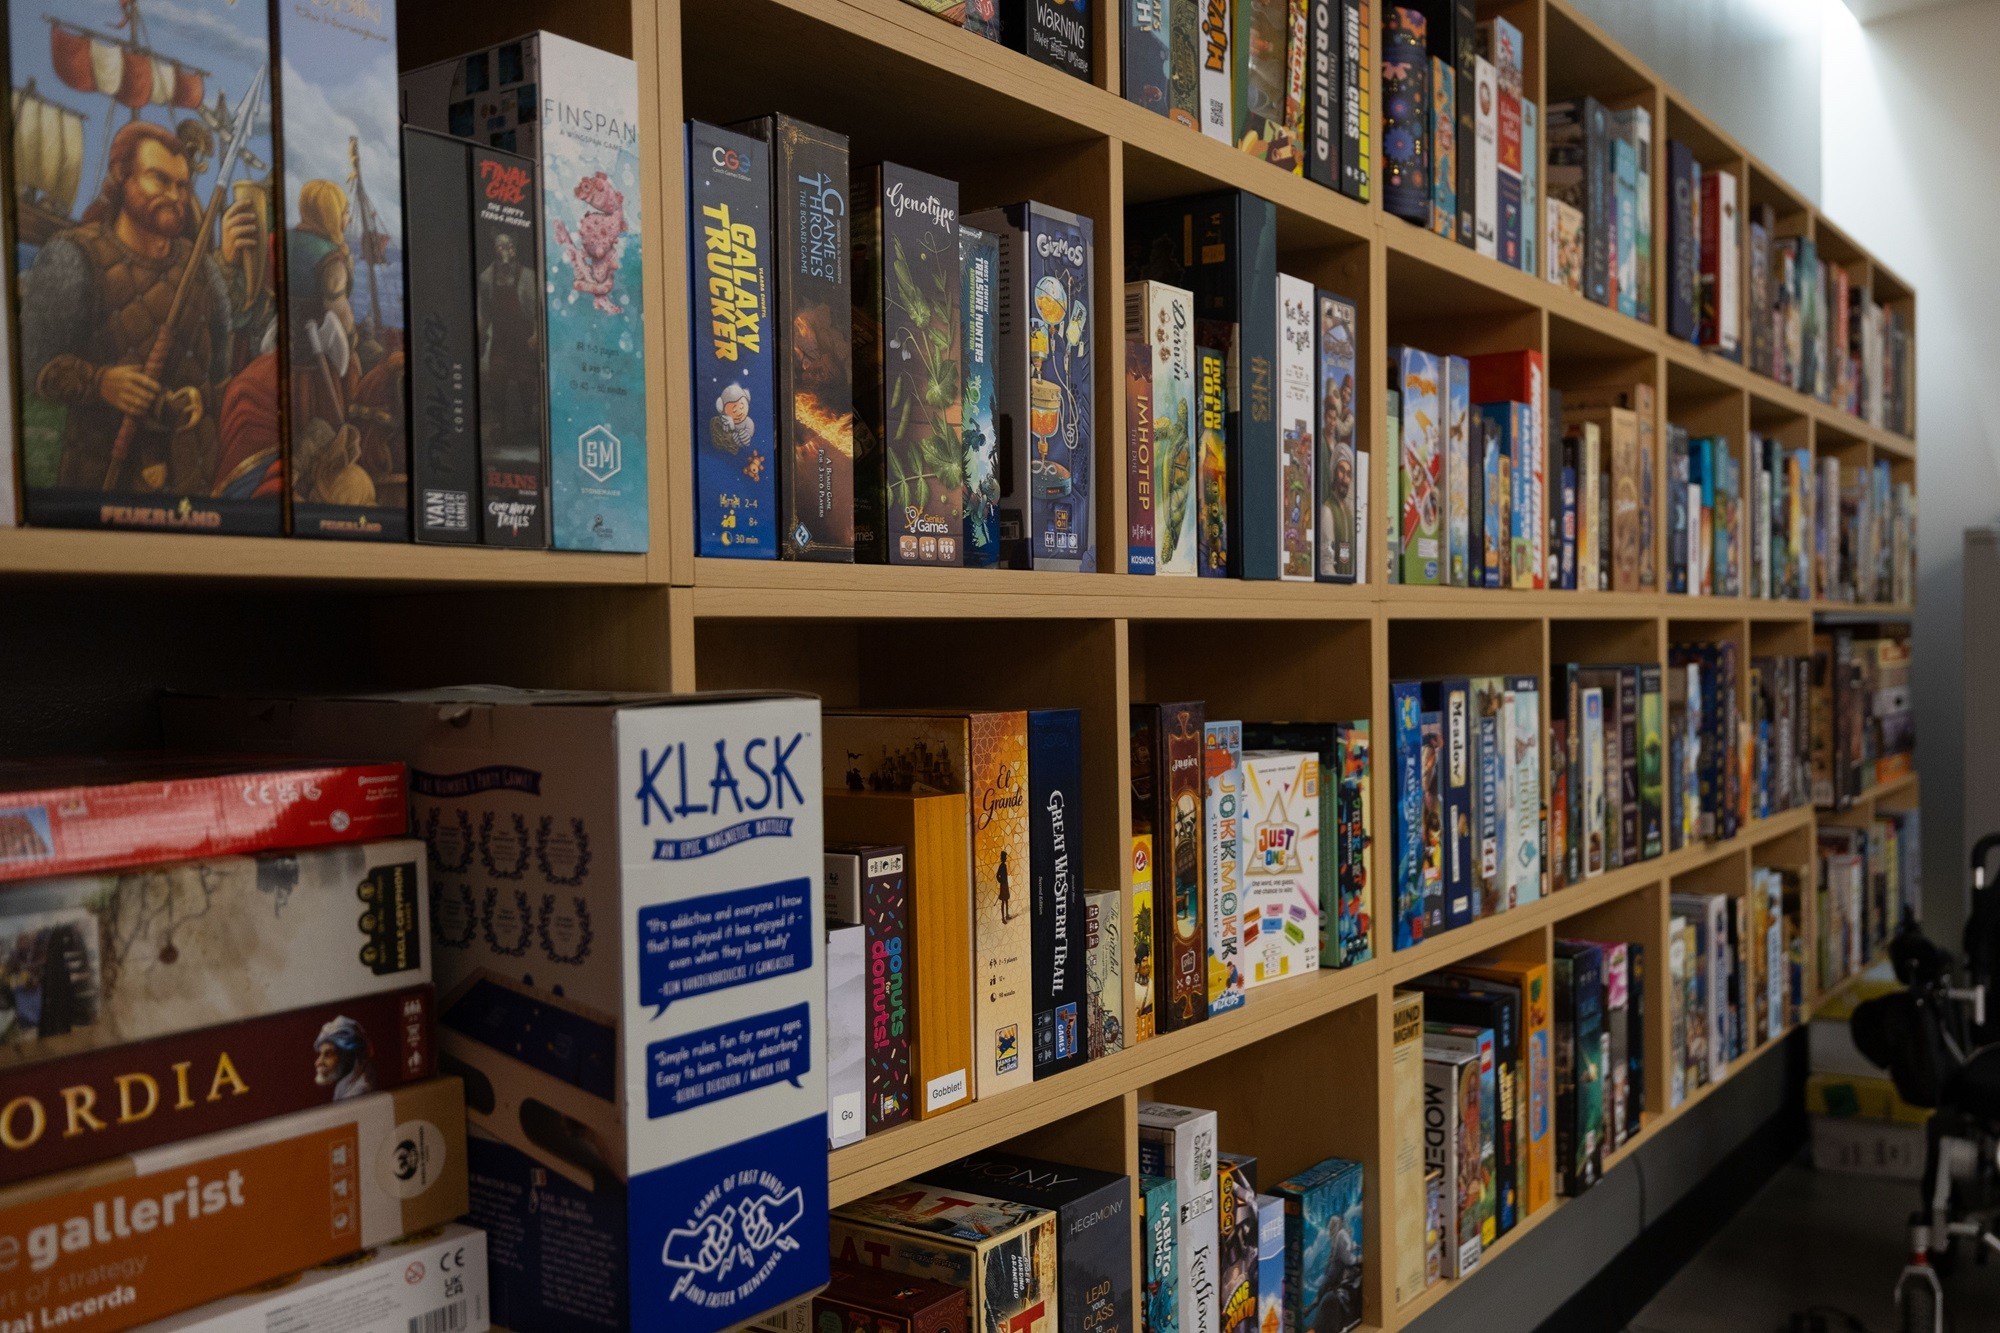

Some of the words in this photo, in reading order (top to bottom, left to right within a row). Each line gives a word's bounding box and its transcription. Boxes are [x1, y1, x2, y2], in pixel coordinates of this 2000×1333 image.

[1036, 0, 1085, 49] WARNING
[1348, 5, 1359, 61] HUES
[1291, 16, 1306, 96] STREAK
[1316, 0, 1329, 161] ORRIFIED
[544, 98, 637, 143] FINSPAN
[1348, 86, 1359, 140] CUES
[480, 160, 530, 186] FINAL
[485, 180, 524, 204] GIRL
[712, 166, 724, 174] Czech
[725, 170, 737, 178] Games
[737, 174, 752, 182] Edition
[823, 173, 832, 184] A
[798, 171, 823, 277] THRONES
[821, 188, 845, 261] GAME
[886, 183, 956, 234] Genotype
[703, 202, 738, 361] TRUCKER
[800, 247, 808, 274] GAME
[825, 264, 834, 283] OF
[730, 223, 760, 353] GALAXY
[974, 257, 984, 312] TREASURE
[974, 314, 984, 364] HUNTERS
[1172, 299, 1186, 382] Darwin
[453, 362, 463, 390] BOX
[1203, 356, 1214, 428] GOLD
[1212, 358, 1222, 430] INCAN
[453, 399, 463, 433] CORE
[587, 441, 614, 469] SM
[1137, 395, 1150, 510] IMHOTEP
[426, 492, 444, 527] VAN
[444, 493, 455, 528] RYDER
[456, 494, 467, 528] GAMES
[748, 517, 758, 526] 8+
[917, 519, 948, 534] Games
[924, 513, 945, 524] Genius
[735, 533, 746, 543] 30
[747, 532, 758, 544] min
[1131, 555, 1154, 566] KOSMOS
[1450, 699, 1464, 780] Meadow
[636, 732, 805, 826] KLASK
[997, 764, 1011, 789] El
[1481, 719, 1496, 837] MEMOIR
[978, 788, 1023, 830] Grande
[1047, 789, 1067, 852] GREAT
[659, 844, 676, 858] AN
[680, 839, 702, 857] EPIC
[706, 825, 752, 851] MAGNETIC
[755, 819, 790, 835] BATTLE!
[1259, 828, 1295, 852] JUST
[1265, 849, 1285, 866] ONE
[1218, 775, 1238, 960] JOKKMOKK
[670, 912, 713, 930] addictive
[714, 905, 732, 921] and
[733, 901, 774, 919] everyone
[781, 894, 803, 908] know
[1053, 852, 1069, 940] WESTERN
[1212, 886, 1220, 929] MARKET
[646, 937, 670, 954] that
[672, 935, 690, 949] has
[692, 926, 723, 948] played
[724, 924, 733, 938] it
[735, 922, 752, 937] has
[753, 915, 786, 934] enjoyed
[787, 912, 795, 926] it
[885, 936, 903, 972] go
[1104, 923, 1119, 976] Grizzled
[668, 956, 693, 971] even
[694, 949, 720, 964] when
[721, 943, 743, 960] they
[744, 939, 762, 954] lose
[1051, 938, 1069, 997] TRAIL
[871, 940, 890, 1051] donuts!
[889, 972, 905, 1038] nuts
[738, 1030, 752, 1043] for
[755, 1025, 780, 1039] many
[1393, 1006, 1420, 1028] MIND
[1393, 1024, 1420, 1044] MGMT
[1057, 1024, 1066, 1053] GAMES
[656, 1070, 682, 1088] Easy
[683, 1066, 696, 1079] to
[725, 1050, 756, 1069] Deeply
[775, 1057, 791, 1074] FUN
[932, 1080, 963, 1100] Gobblet!
[841, 1108, 854, 1121] Go
[1191, 1135, 1201, 1186] GAMES
[27, 1168, 246, 1273] gallerist
[686, 1219, 698, 1230] A
[693, 1184, 722, 1219] GAME
[722, 1174, 736, 1193] OF
[737, 1169, 760, 1187] FAST
[758, 1171, 786, 1199] HANDS
[1070, 1199, 1124, 1235] HEGEMONY
[1154, 1220, 1163, 1268] SUMO
[1160, 1201, 1171, 1277] KABUTO
[685, 1283, 707, 1306] AND
[704, 1290, 736, 1308] FASTER
[737, 1250, 782, 1300] THINKING
[1011, 1254, 1019, 1299] GRANERUD
[1086, 1280, 1111, 1305] LEAD
[40, 1285, 137, 1330] Lacerda
[1083, 1304, 1115, 1331] CLASS
[1091, 1299, 1106, 1312] YOUR
